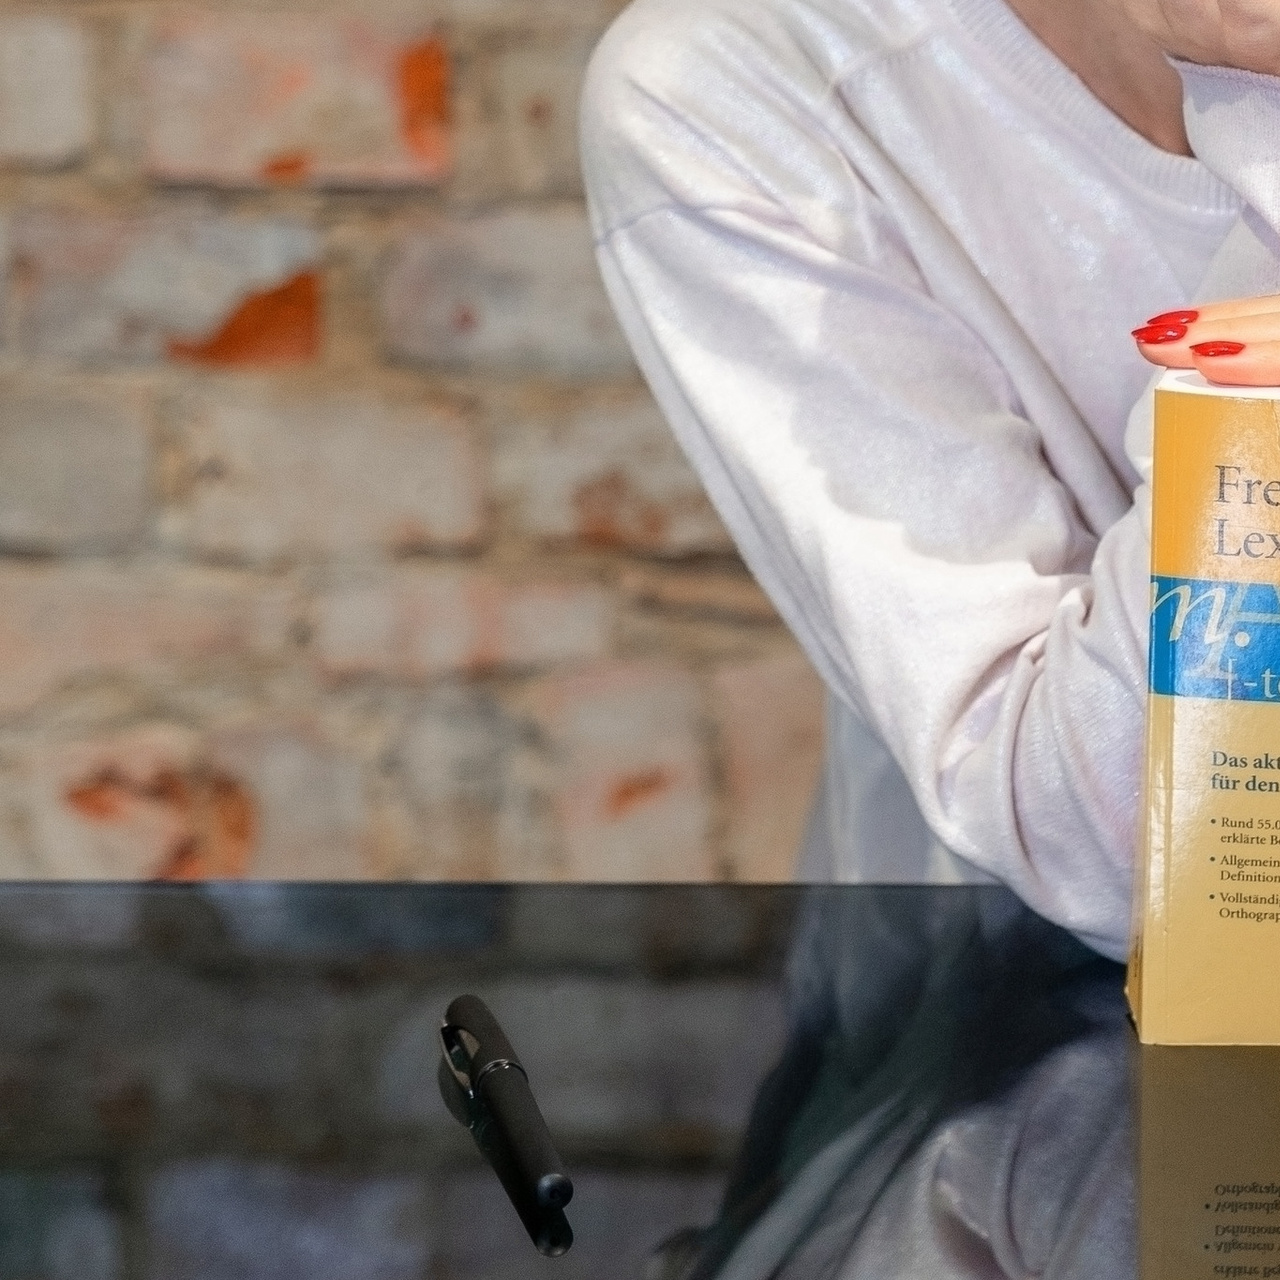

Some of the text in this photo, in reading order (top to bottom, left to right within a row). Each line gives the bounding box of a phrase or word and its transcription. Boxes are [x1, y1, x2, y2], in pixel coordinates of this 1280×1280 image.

[1212, 750, 1248, 768] Das
[1211, 773, 1240, 790] für
[1245, 775, 1280, 793] den
[1221, 817, 1254, 829] Rund
[1220, 832, 1266, 845] erklärte
[1220, 854, 1280, 869] Allgemein
